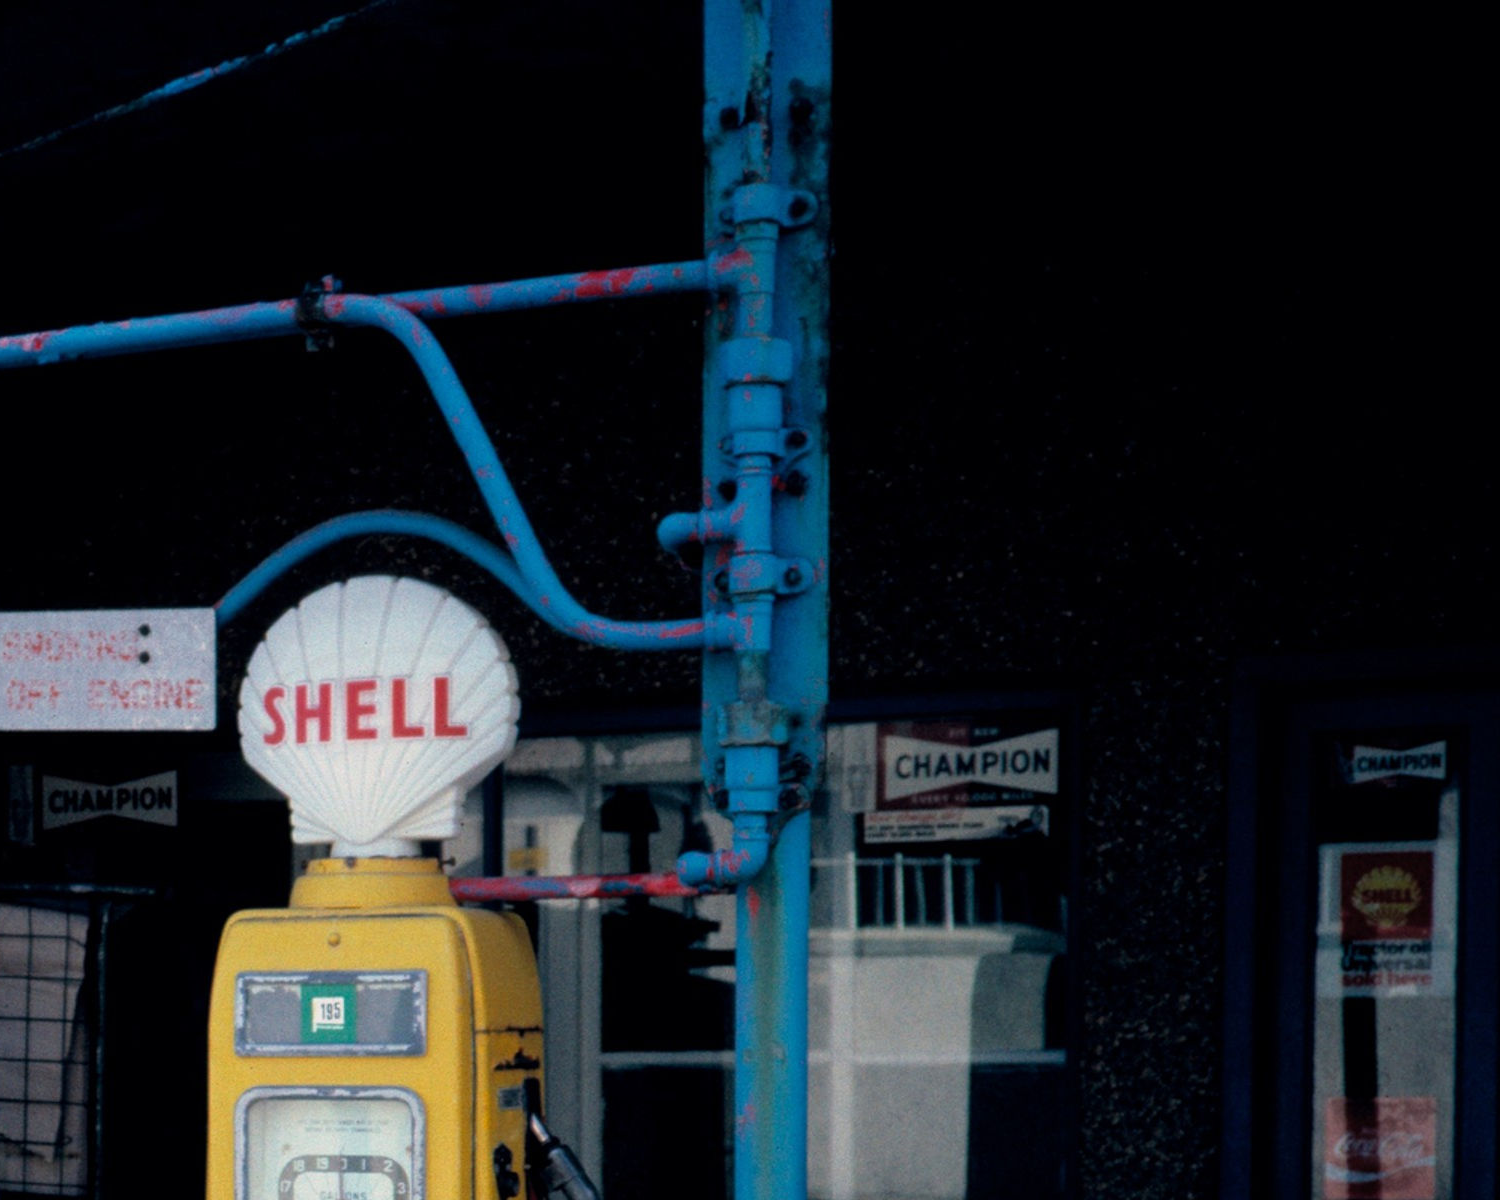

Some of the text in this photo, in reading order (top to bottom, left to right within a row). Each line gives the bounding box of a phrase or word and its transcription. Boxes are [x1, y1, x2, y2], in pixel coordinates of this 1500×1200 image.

[263, 677, 468, 745] SHELL
[896, 749, 1050, 779] CHAMPION
[1358, 753, 1442, 772] CHAMPION
[50, 786, 173, 814] CHAMPION
[1361, 888, 1413, 904] SHELL
[320, 1002, 342, 1020] 195
[361, 1159, 366, 1170] 1
[383, 1159, 393, 1172] 2
[280, 1180, 291, 1193] 17
[397, 1182, 406, 1194] 3
